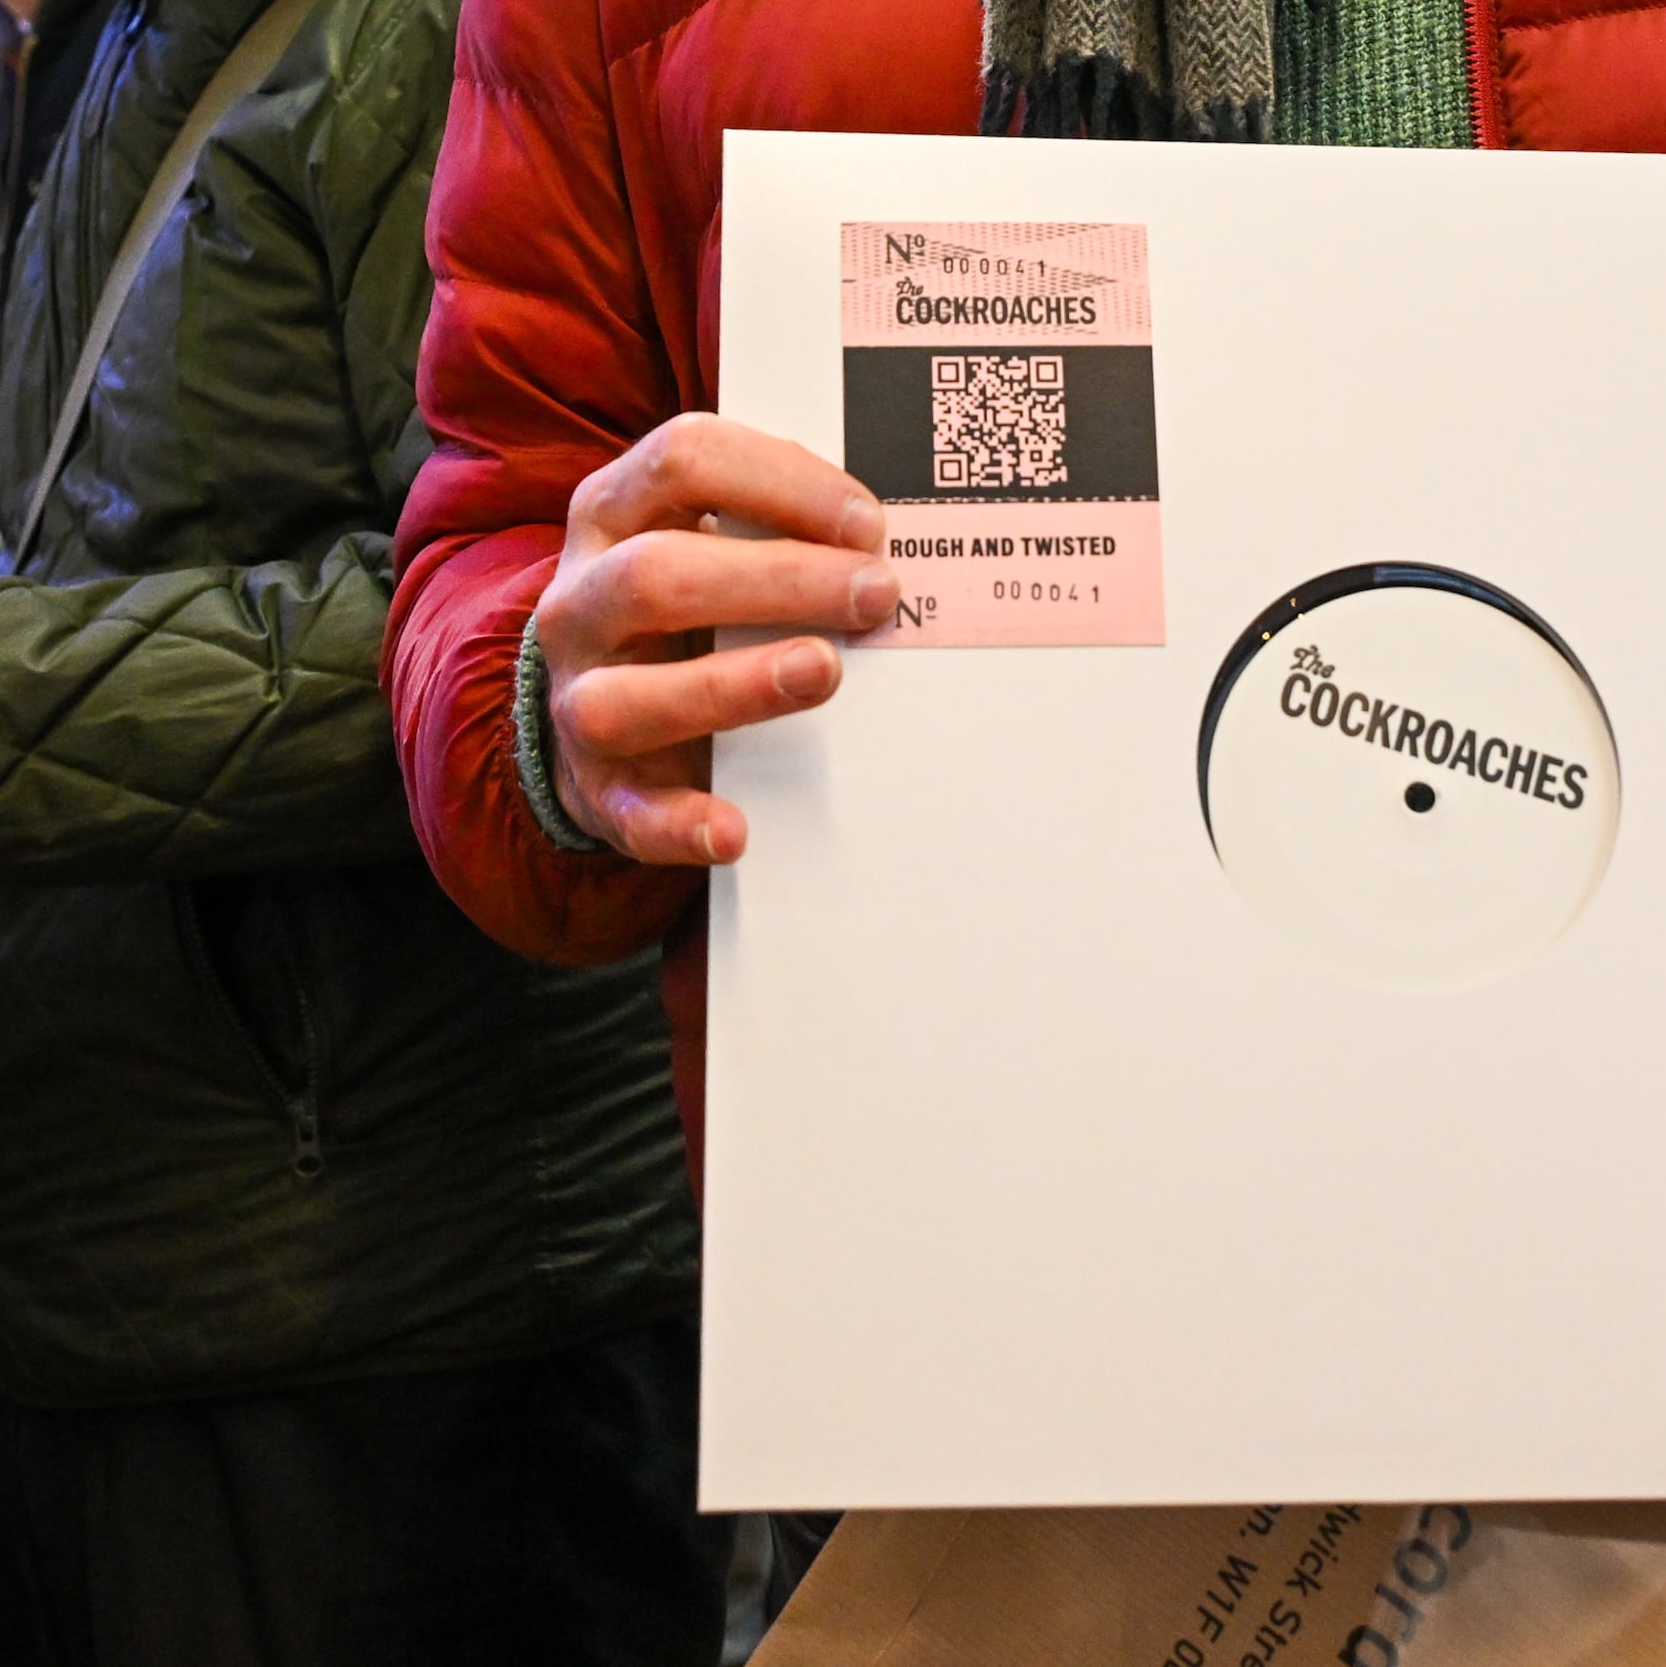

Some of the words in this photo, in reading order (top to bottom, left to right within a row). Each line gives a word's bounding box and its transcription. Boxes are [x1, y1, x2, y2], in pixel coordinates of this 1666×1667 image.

[895, 276, 924, 297] The
[895, 296, 1097, 326] COCKROACHES
[890, 537, 964, 559] ROUGH
[971, 537, 1015, 558] AND
[1021, 535, 1117, 557] TWISTED
[1290, 643, 1336, 680] The
[1280, 672, 1590, 811] COCKROACHES
[1196, 1553, 1259, 1644] W1F
